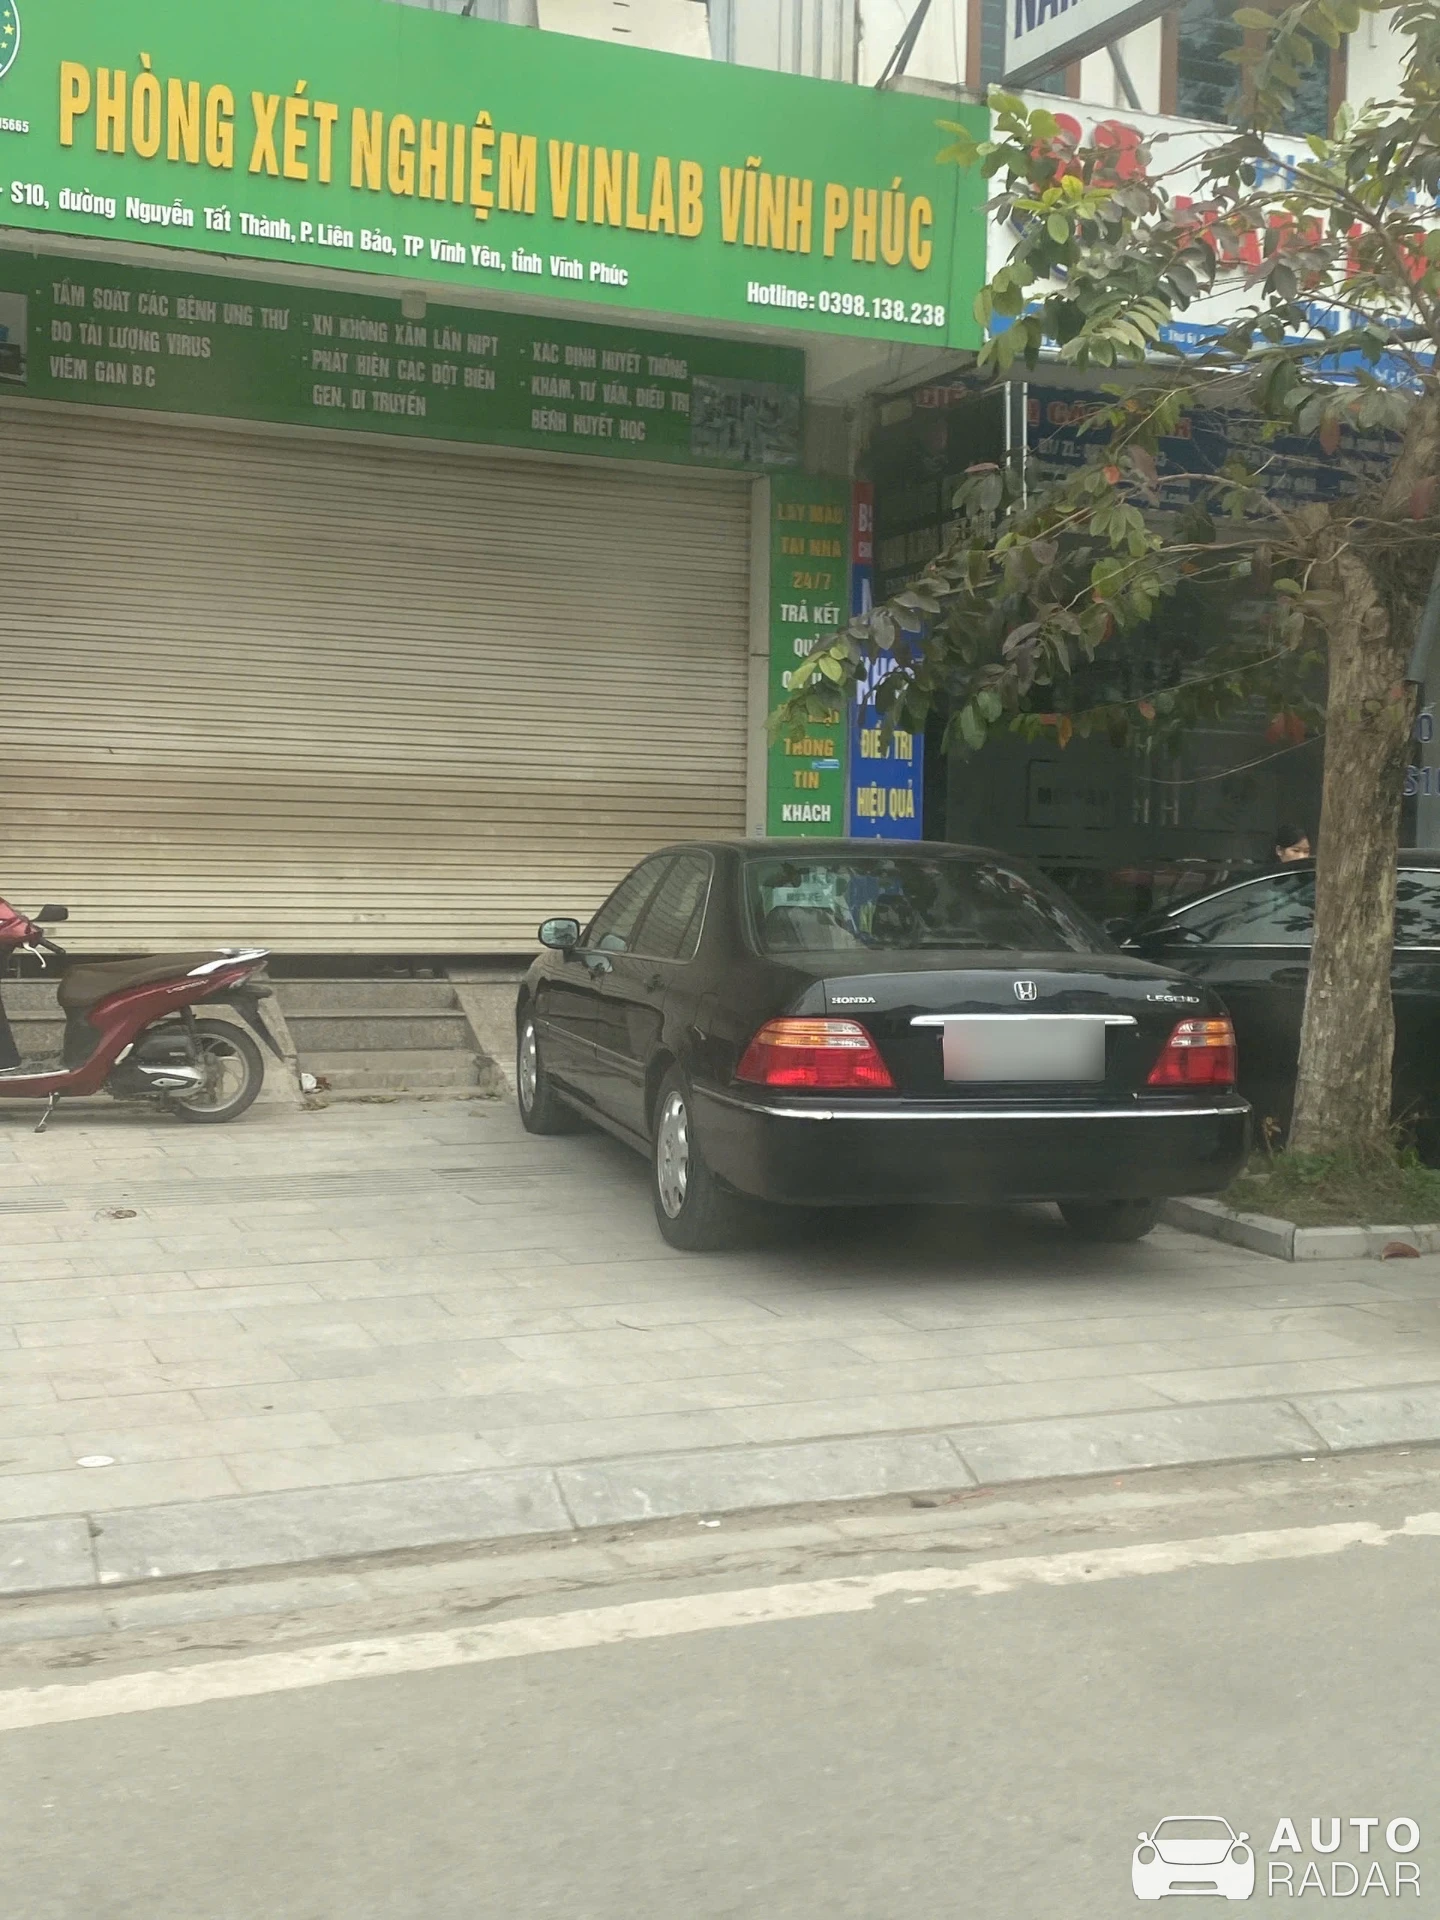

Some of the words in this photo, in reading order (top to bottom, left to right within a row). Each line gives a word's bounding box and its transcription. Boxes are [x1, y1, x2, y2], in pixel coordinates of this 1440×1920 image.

[60, 52, 235, 169] PHÒNG
[248, 79, 338, 184] XÉT
[350, 107, 537, 221] NGHIỆM
[548, 139, 703, 238] VINLAB
[720, 155, 813, 254] VĨNH
[823, 176, 932, 271] PHÚC
[11, 181, 49, 209] S10,
[59, 187, 116, 219] đường
[126, 198, 194, 227] Nguyễn
[204, 205, 231, 232] Tất
[239, 213, 296, 244] Thành,
[360, 228, 397, 256] Bảo,
[403, 235, 424, 258] TP
[430, 239, 466, 264] Vĩnh
[471, 245, 506, 272] Yên,
[511, 247, 542, 275] tỉnh
[550, 255, 584, 280] Vĩnh
[589, 261, 629, 287] Phúc
[52, 277, 85, 307] TẦM
[138, 290, 169, 316] CÁC
[176, 294, 216, 325] BỆNH
[260, 306, 290, 331] THƯ
[747, 281, 815, 310] Hotline:
[818, 290, 946, 327] 0398.138.238
[109, 325, 160, 355] LƯỢNG
[166, 333, 212, 358] VIRUS
[312, 313, 333, 336] XN
[339, 316, 387, 343] KHÔNG
[467, 333, 499, 356] NIPT
[50, 353, 88, 380] VIÊM
[95, 360, 128, 384] GAN
[352, 388, 366, 410] DI
[792, 571, 832, 590] 24/7
[781, 599, 809, 623] TRẢ
[813, 602, 841, 625] KẾT
[794, 771, 820, 789] TIN
[782, 801, 832, 822] KHÁCH
[857, 781, 886, 824] HIỆU
[889, 779, 915, 821] QUẢ
[831, 996, 876, 1004] HONDA
[1146, 994, 1200, 1004] LEGEND
